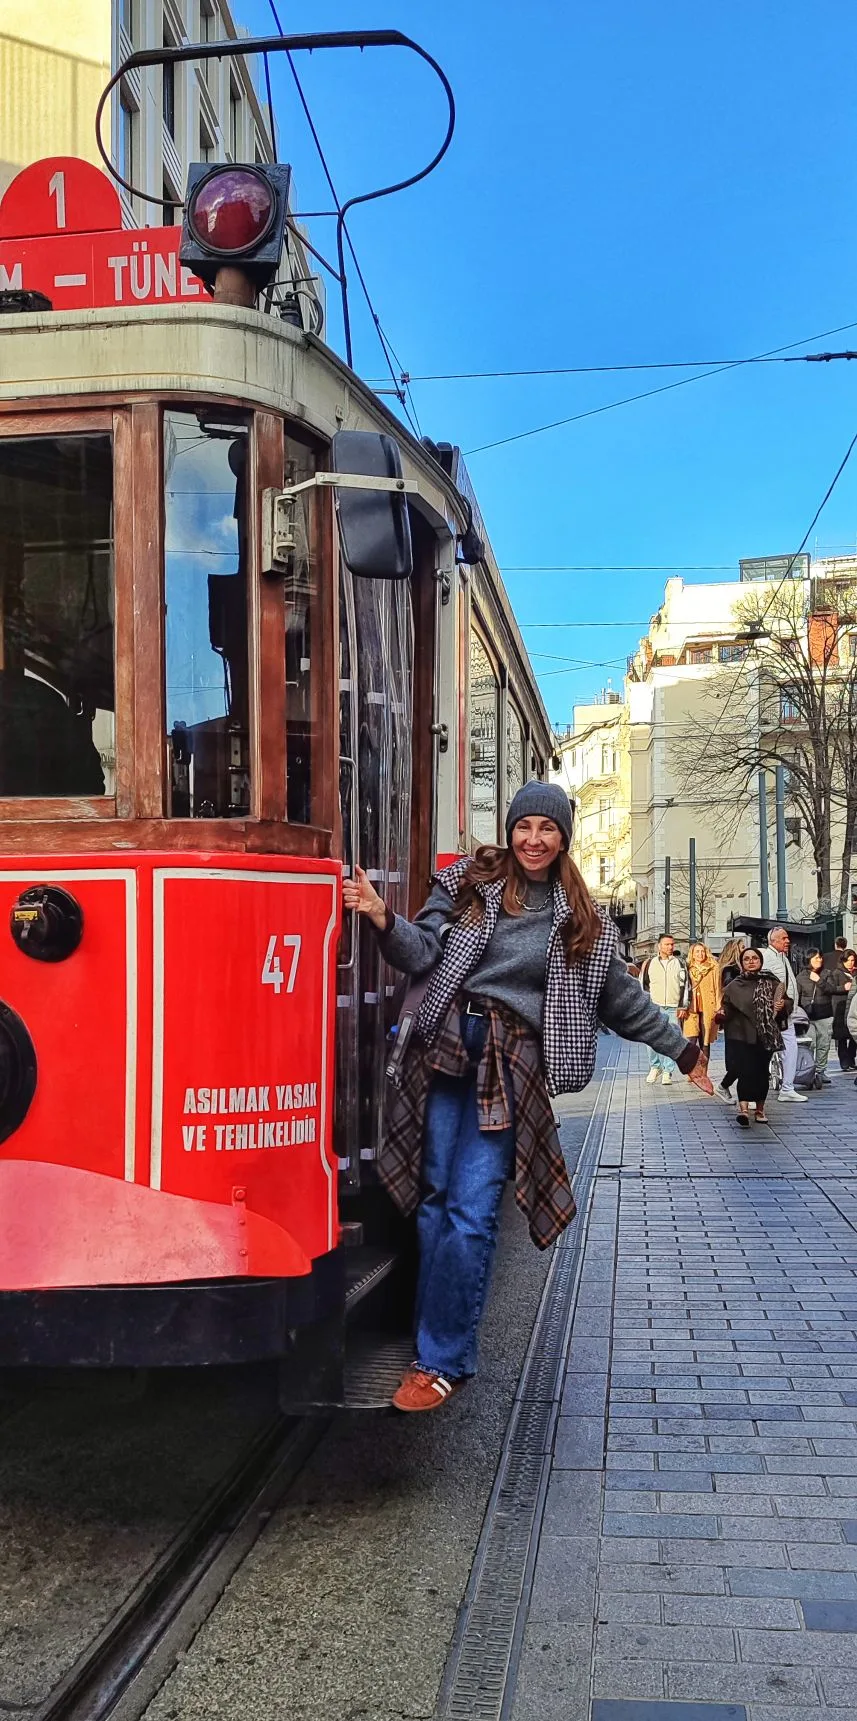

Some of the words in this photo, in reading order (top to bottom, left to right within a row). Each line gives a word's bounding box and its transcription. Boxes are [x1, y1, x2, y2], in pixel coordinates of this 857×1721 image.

[48, 171, 66, 229] 1
[107, 241, 209, 301] TÜNE
[261, 934, 301, 994] 47
[183, 1085, 270, 1115] ASILMAK
[275, 1082, 317, 1111] YASAK
[181, 1125, 207, 1152] VE
[213, 1114, 316, 1152] TEHLİKELİDİR
